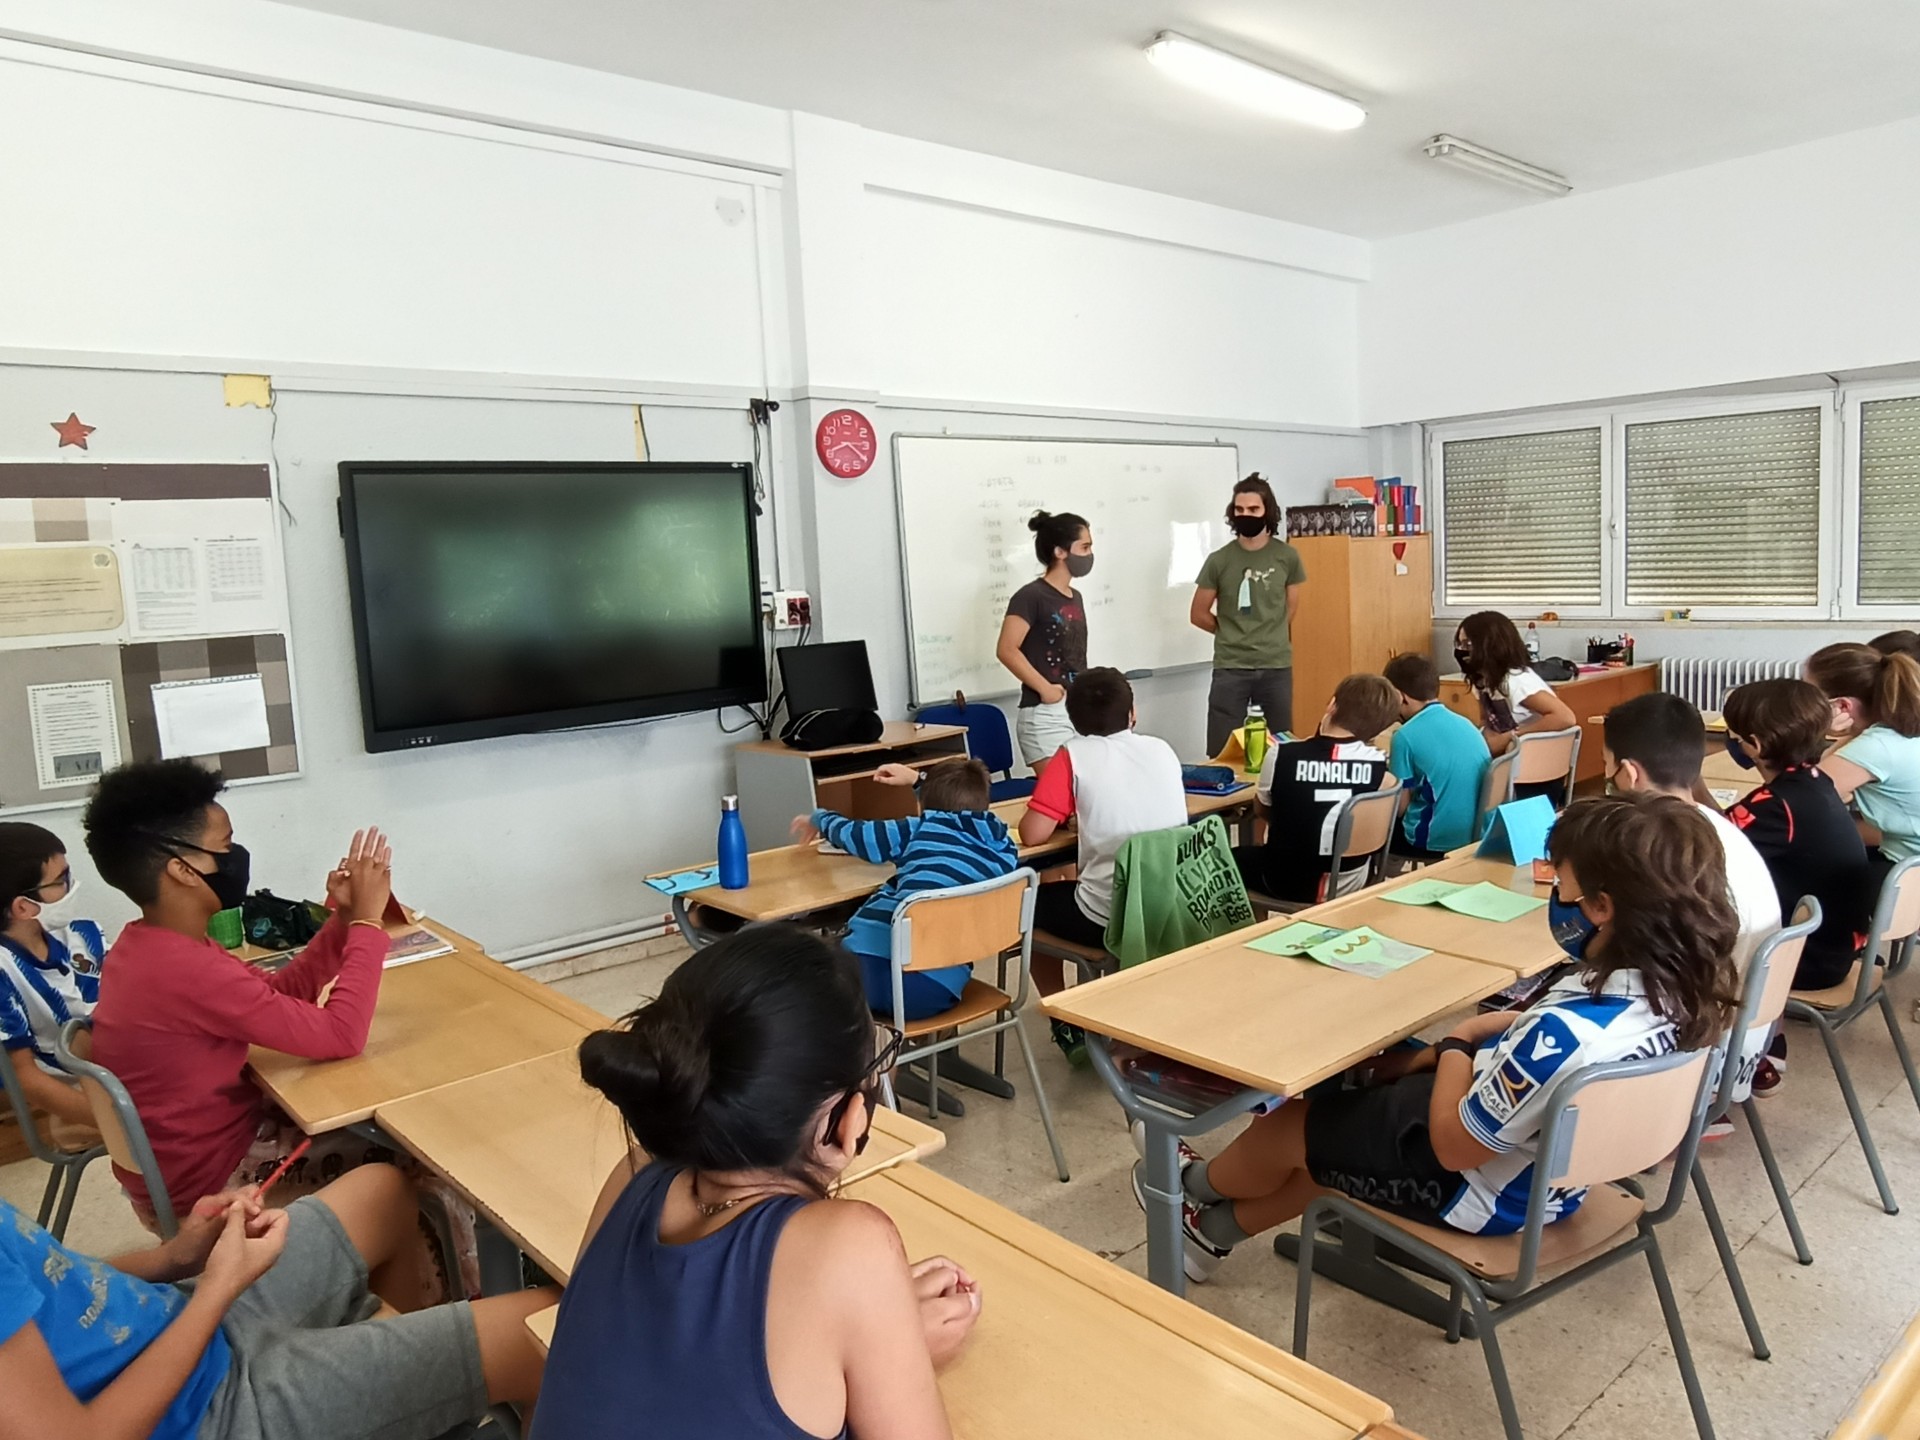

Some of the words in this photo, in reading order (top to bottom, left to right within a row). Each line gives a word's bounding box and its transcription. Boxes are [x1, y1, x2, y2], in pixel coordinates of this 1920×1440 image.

[832, 418, 841, 428] 11
[841, 414, 852, 426] 12
[825, 425, 836, 436] 10
[859, 427, 868, 438] 2
[823, 436, 832, 446] 9
[862, 440, 870, 451] 3
[834, 458, 841, 469] 7
[842, 463, 851, 473] 6
[852, 460, 861, 470] 5
[1295, 760, 1373, 785] RONALDO
[1314, 788, 1353, 856] 7
[1223, 903, 1253, 926] 1969
[1482, 1084, 1511, 1117] REALE
